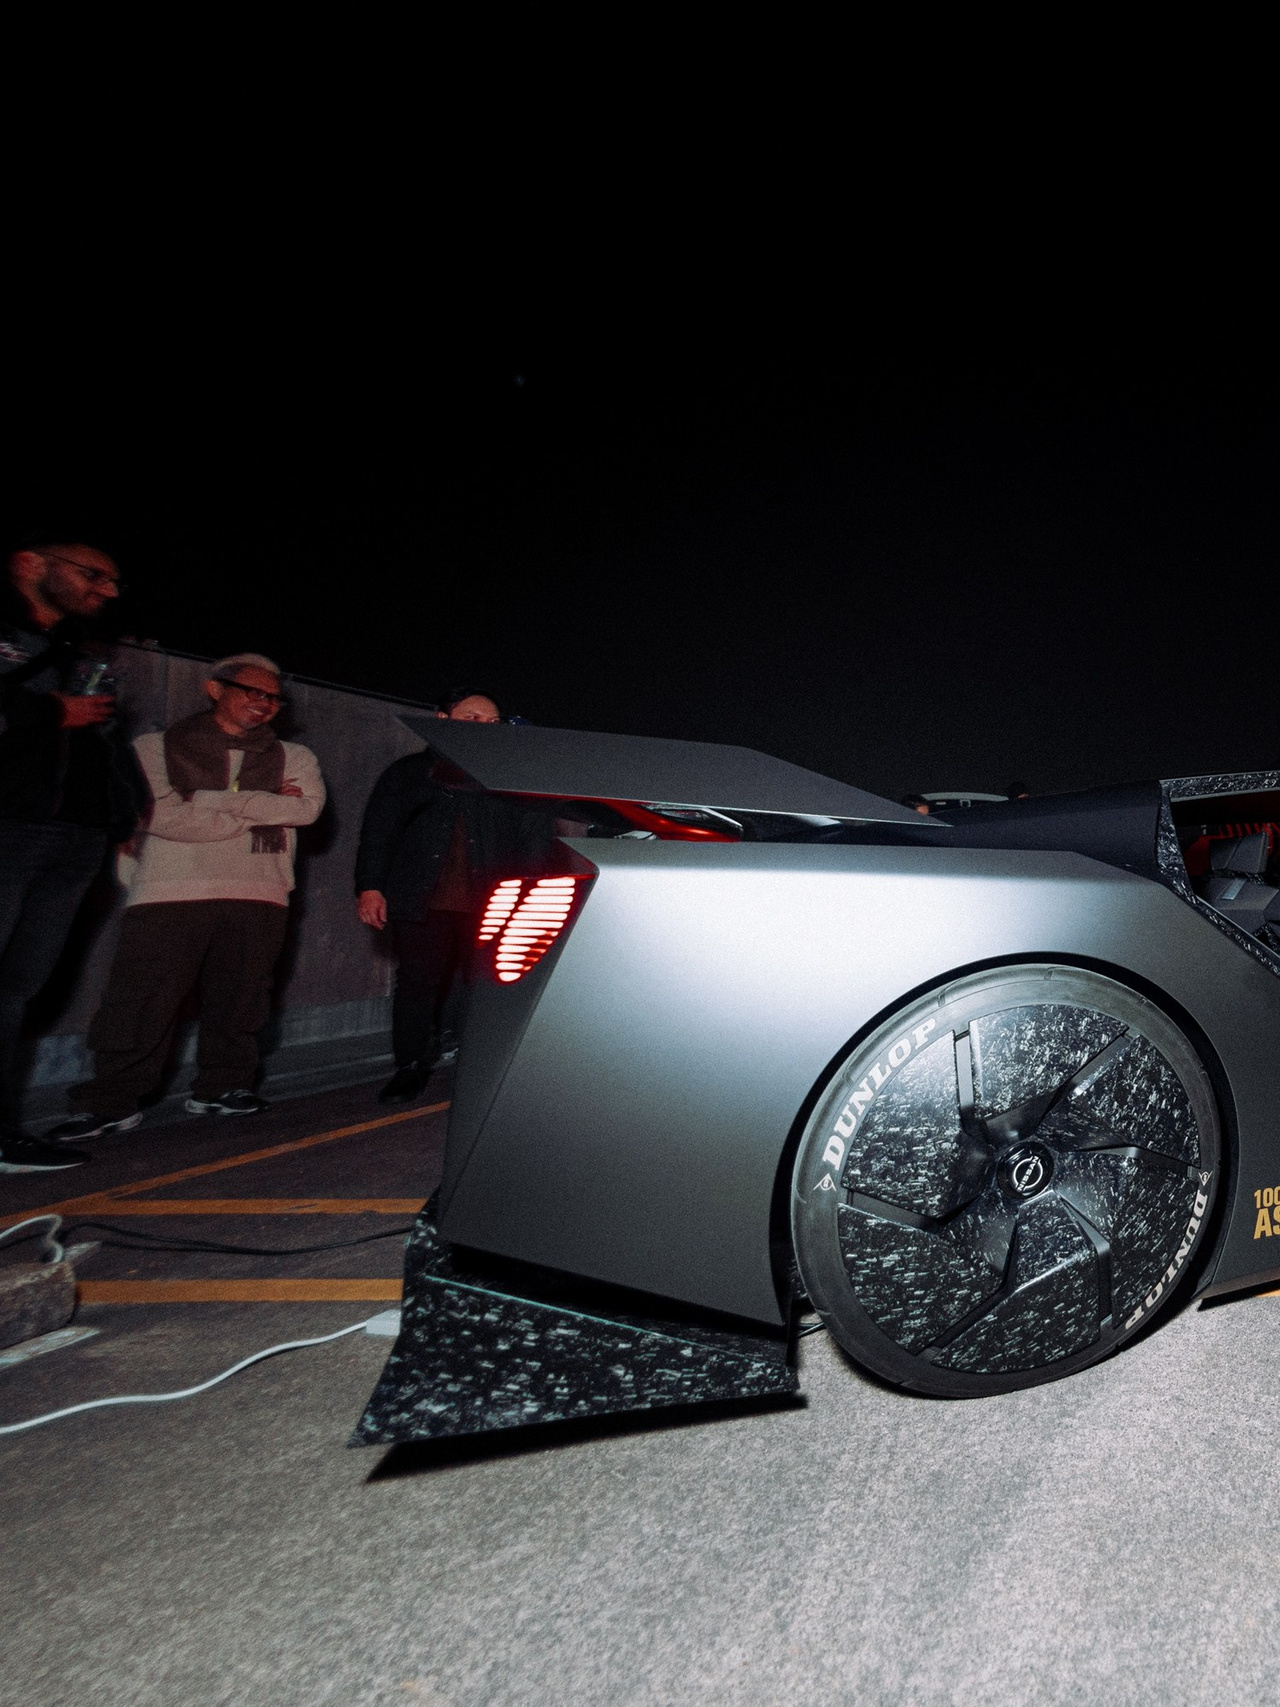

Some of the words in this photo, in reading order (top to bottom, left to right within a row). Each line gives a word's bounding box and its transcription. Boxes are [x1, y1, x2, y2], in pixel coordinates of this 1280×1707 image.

[823, 1018, 936, 1171] DUNLOP
[1017, 1155, 1040, 1191] NISSAN
[1125, 1189, 1208, 1330] DUNLOP
